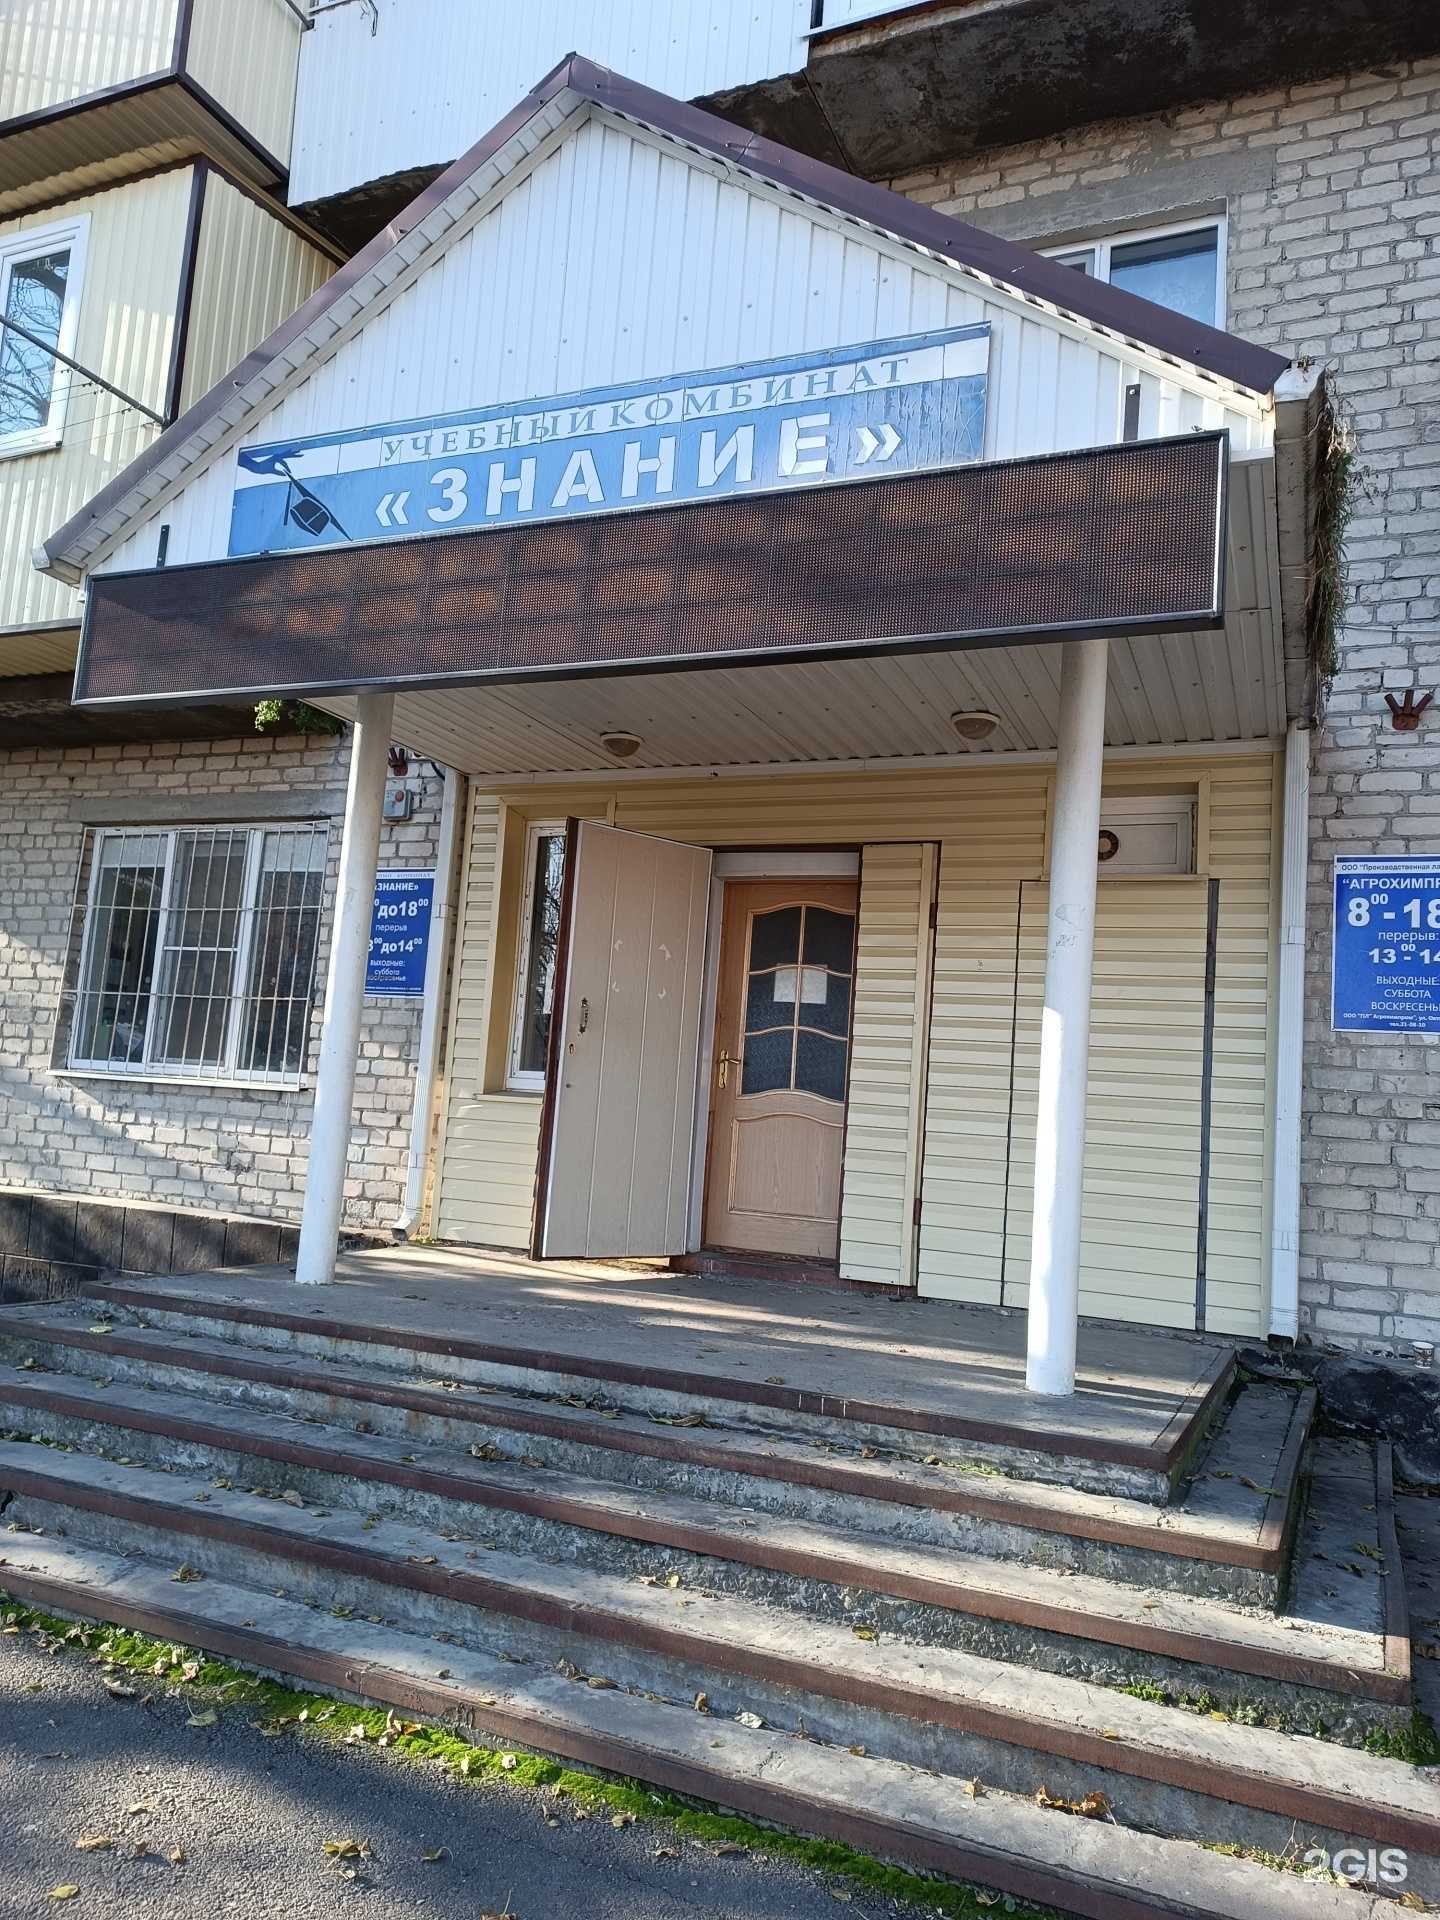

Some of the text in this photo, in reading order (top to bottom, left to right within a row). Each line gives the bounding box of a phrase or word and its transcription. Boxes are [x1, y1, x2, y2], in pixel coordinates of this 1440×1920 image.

[383, 357, 910, 462] УЧЕБНЫЙ КОМБИНАТ
[1384, 988, 1432, 999] СУББОТА
[1371, 1001, 1440, 1012] ВОСКРЕСЕНЬ
